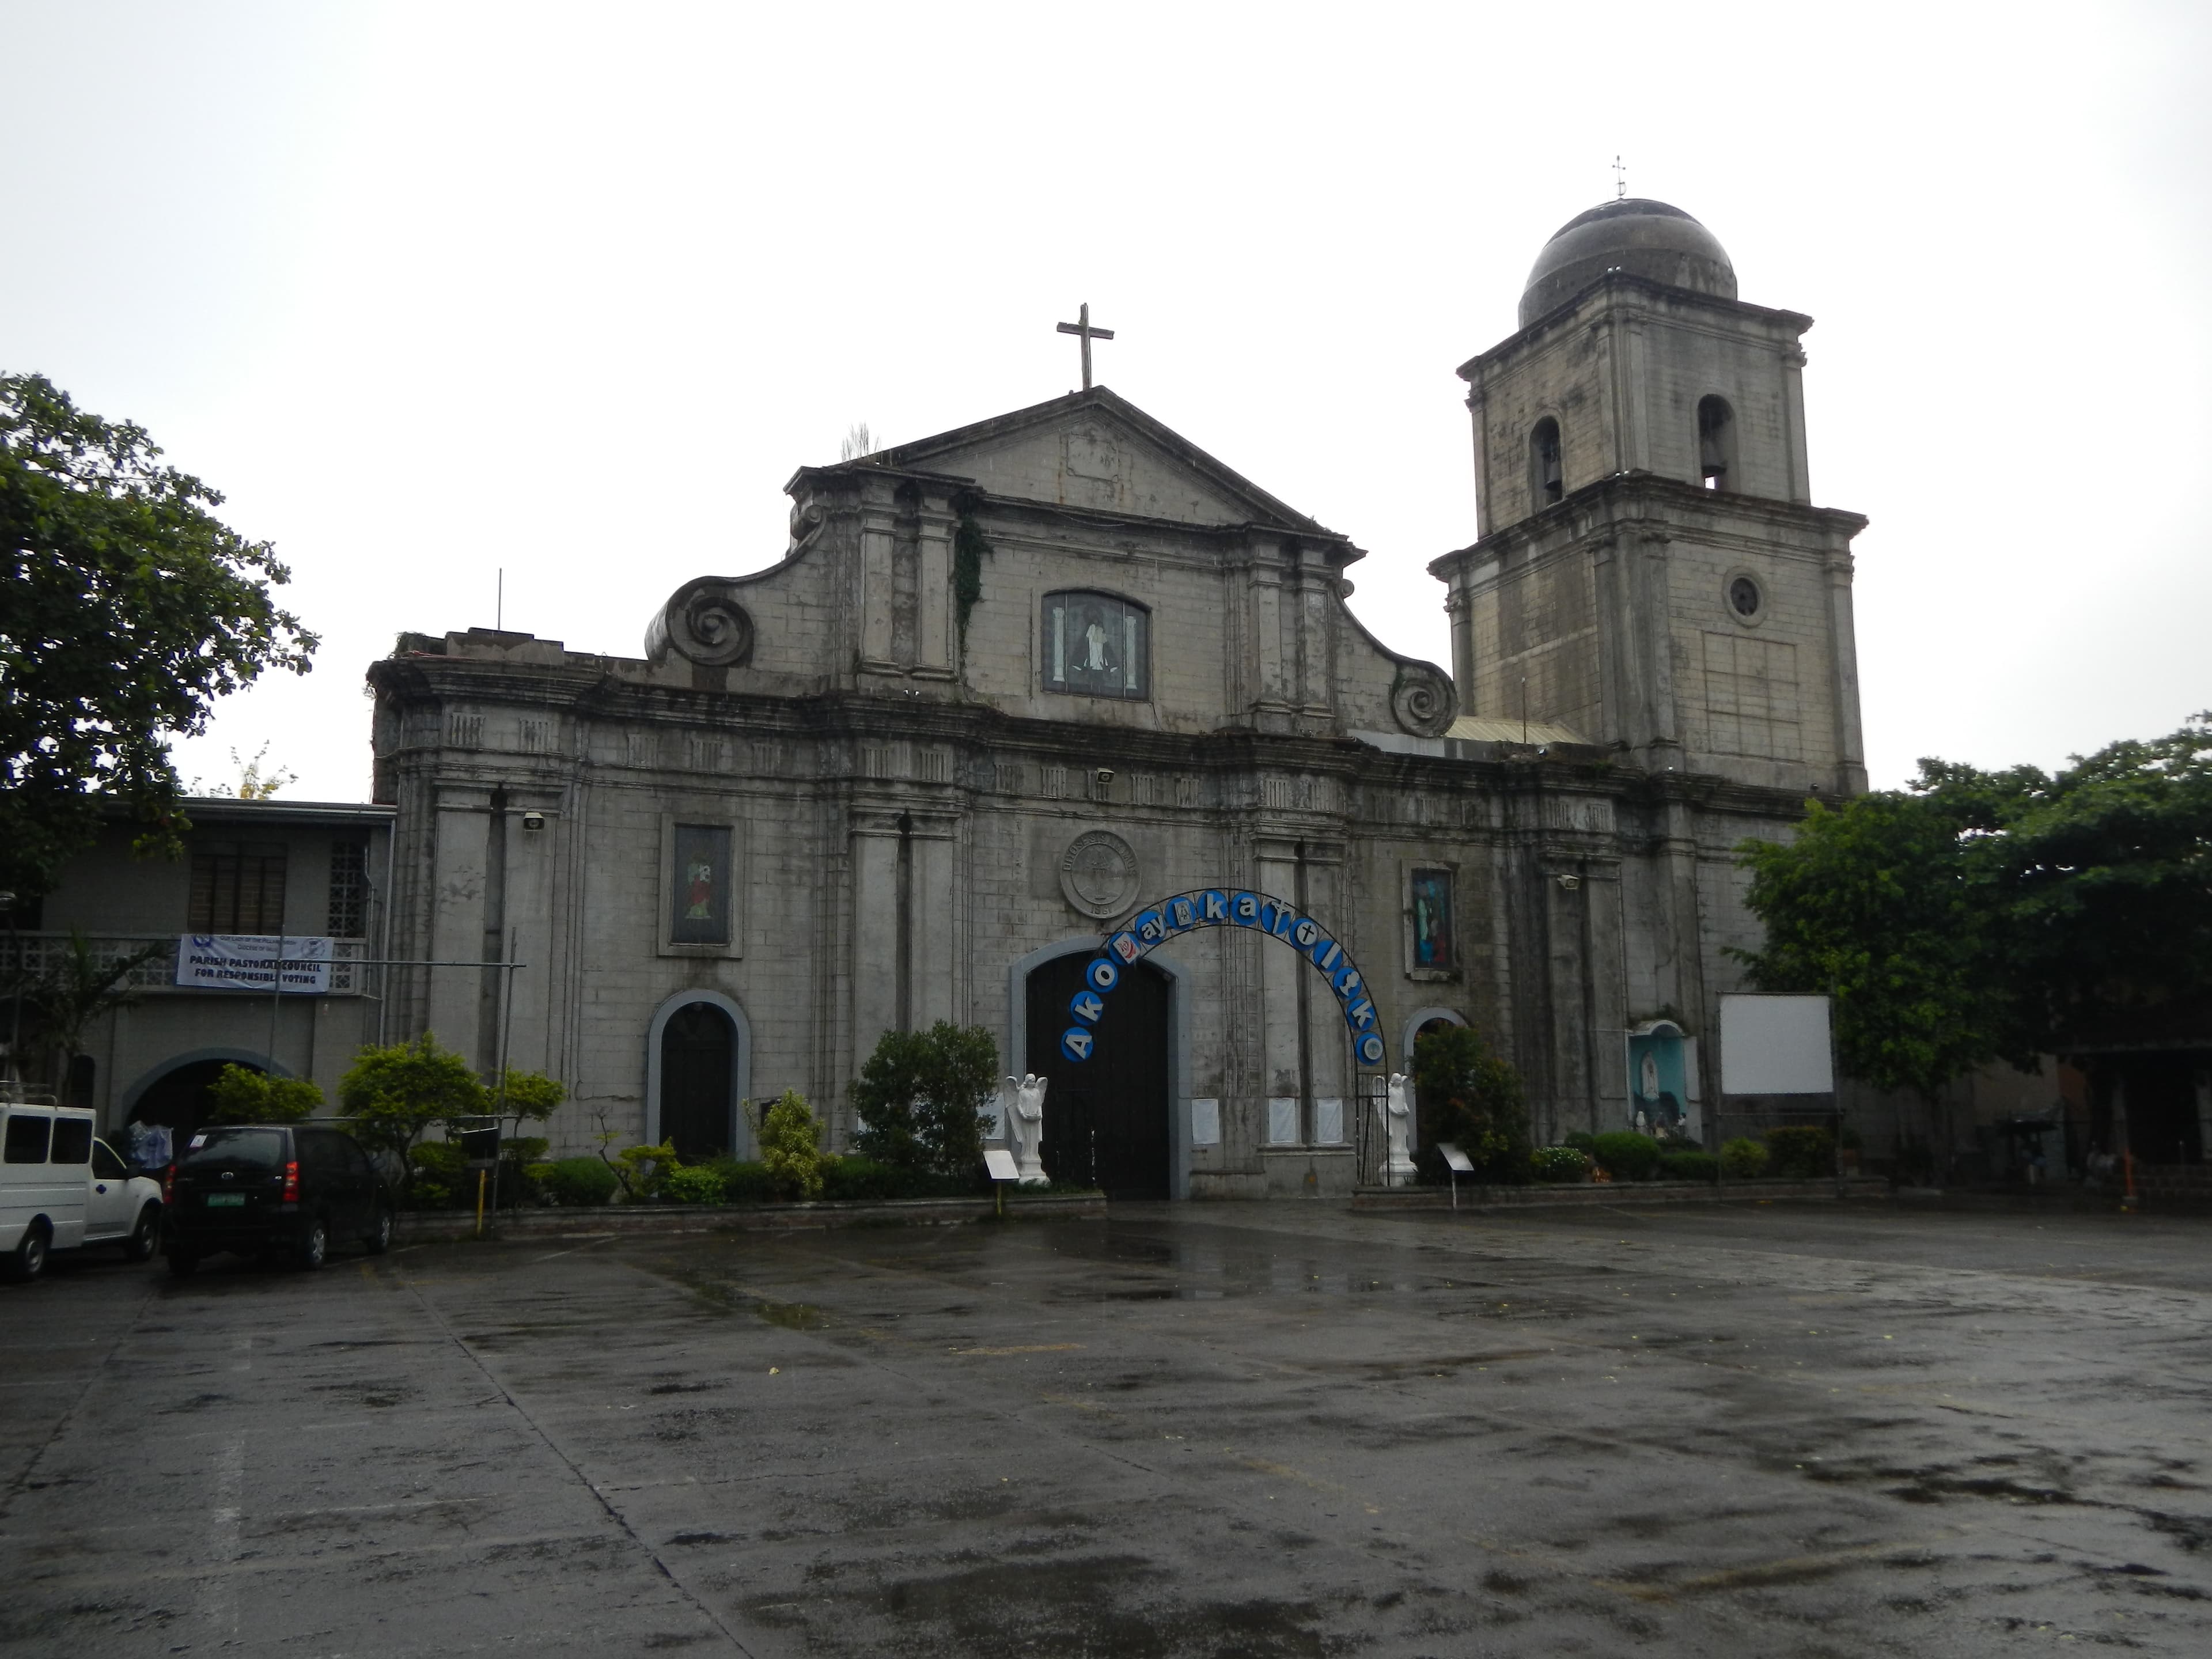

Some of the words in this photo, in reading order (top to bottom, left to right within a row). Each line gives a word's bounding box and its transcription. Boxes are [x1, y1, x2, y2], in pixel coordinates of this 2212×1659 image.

[1141, 915, 1165, 940] ay
[190, 955, 226, 967] PARISH
[229, 958, 279, 970] PASTORAL
[282, 961, 321, 972] COUNCIL
[195, 968, 214, 978] FOR
[217, 970, 279, 982] RESPONSIBL
[282, 974, 316, 984] VOTING
